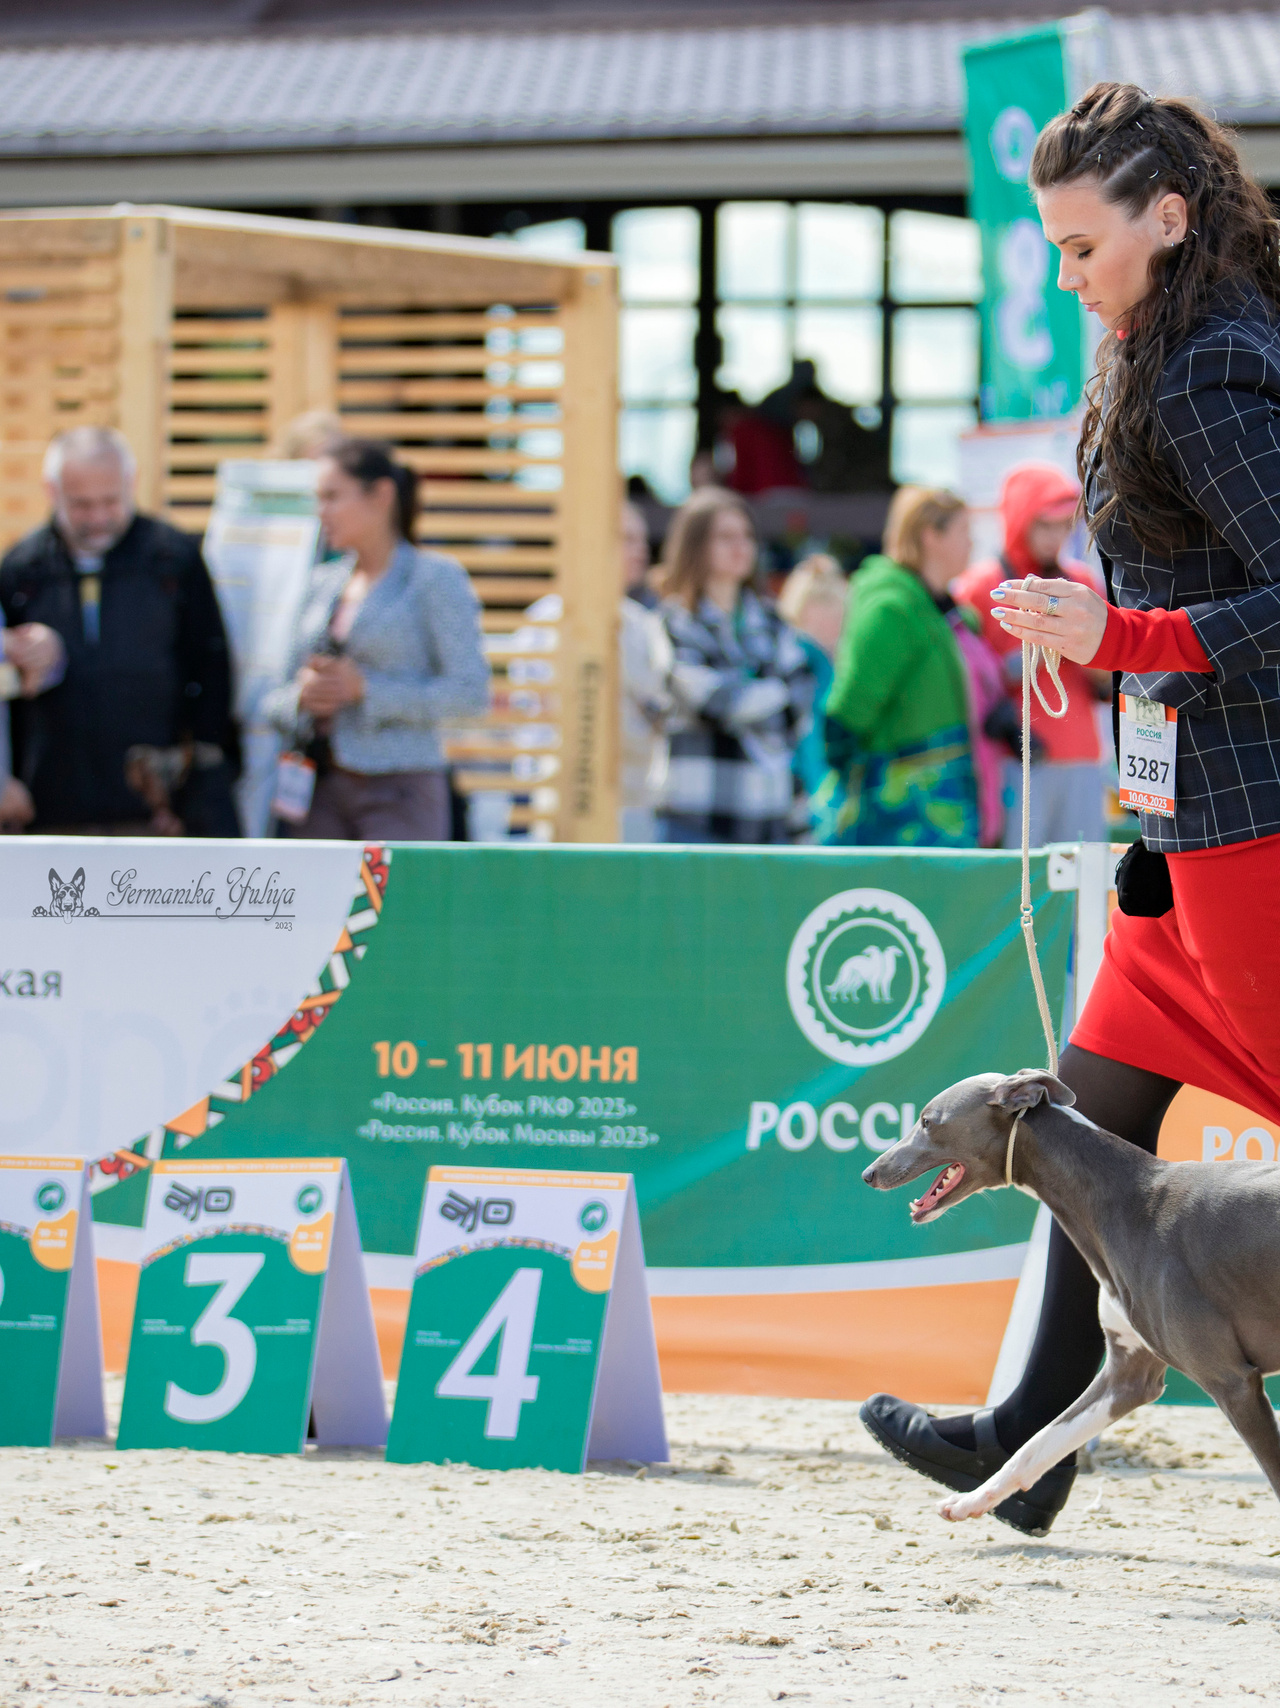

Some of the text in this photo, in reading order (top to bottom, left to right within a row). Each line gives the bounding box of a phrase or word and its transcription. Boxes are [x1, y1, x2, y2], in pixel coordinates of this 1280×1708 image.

[1136, 727, 1162, 740] РОССИЯ
[1127, 754, 1170, 784] 3287
[1128, 791, 1168, 809] 10.06.2023
[372, 1041, 418, 1079] 10
[457, 1043, 493, 1079] 11
[502, 1043, 639, 1083] ИЮНЯ
[460, 1094, 524, 1121] Кубок
[526, 1095, 575, 1118] РКФ
[446, 1121, 510, 1149] Кубок
[512, 1123, 597, 1147] Москвы
[165, 1253, 266, 1424] 3
[435, 1267, 543, 1440] 4
